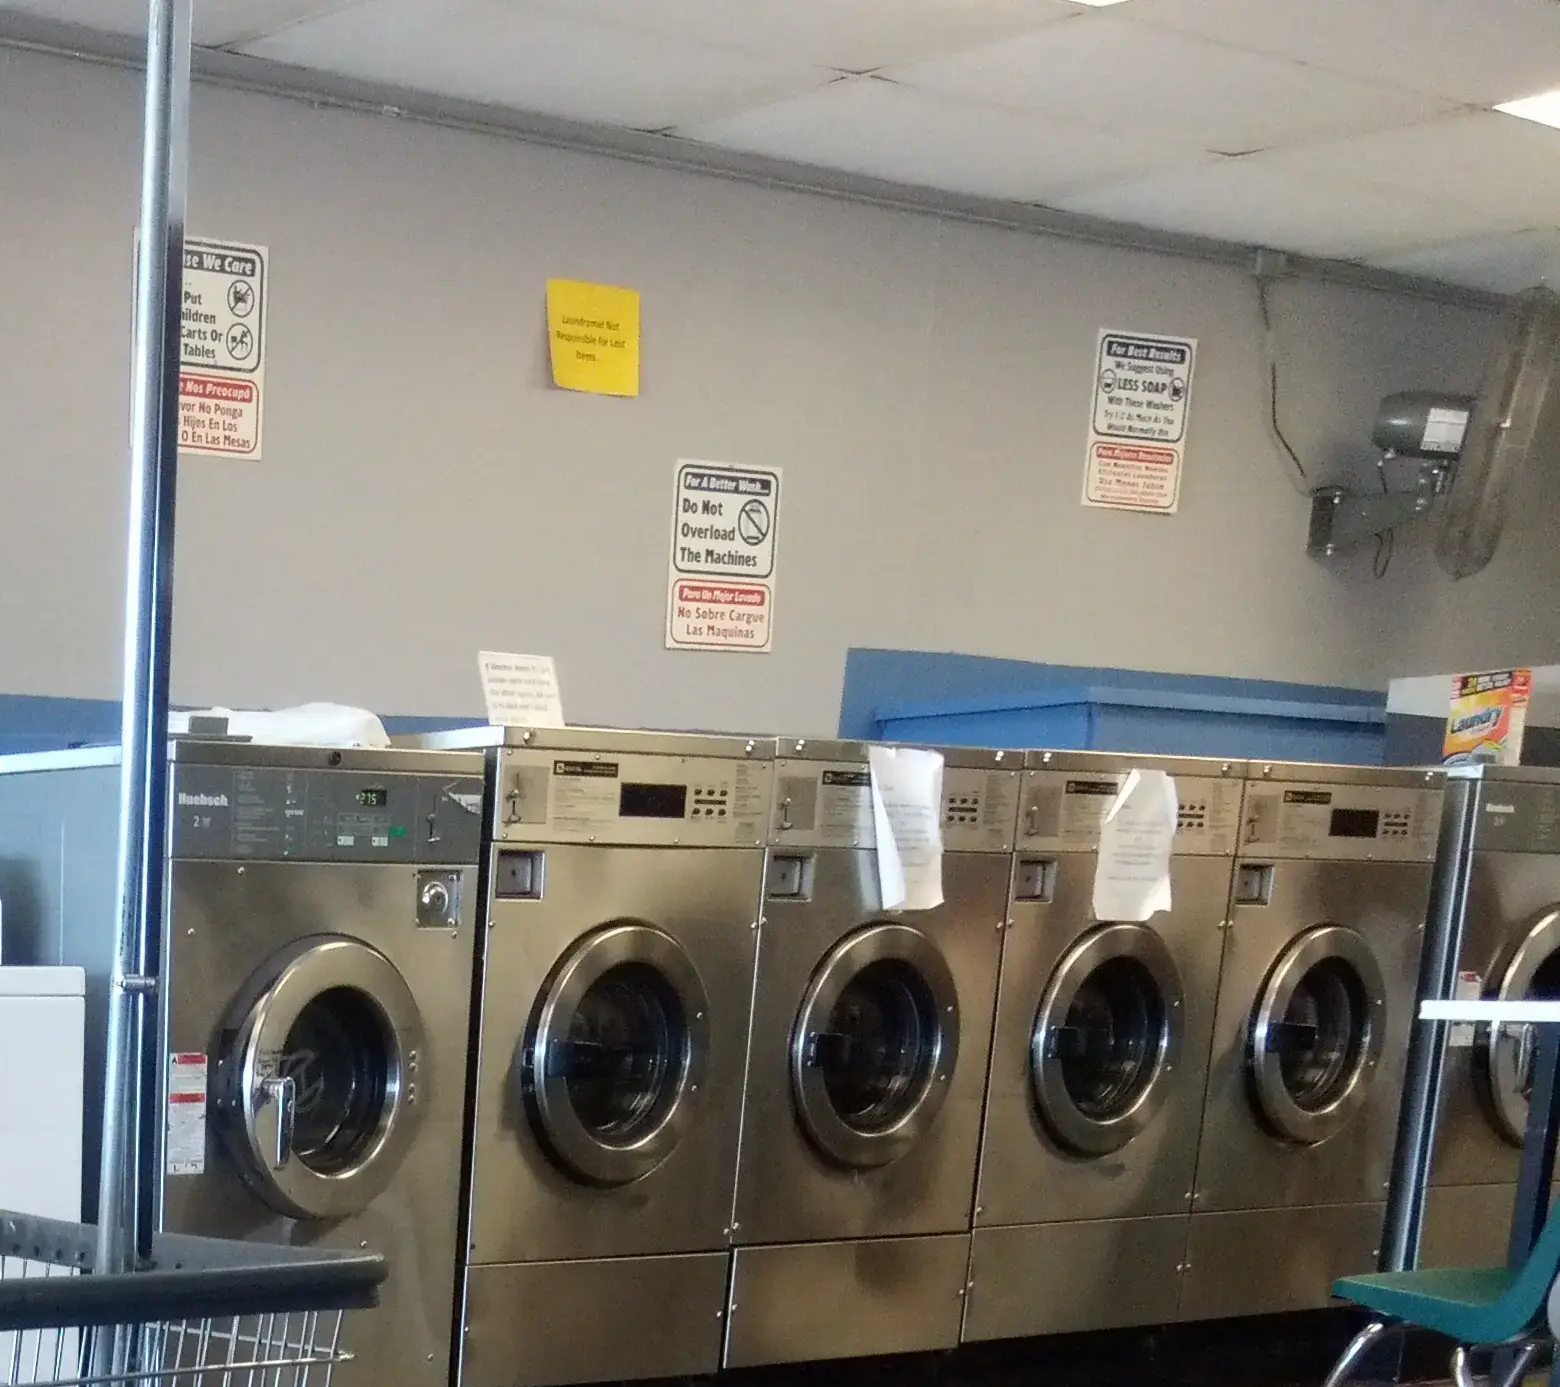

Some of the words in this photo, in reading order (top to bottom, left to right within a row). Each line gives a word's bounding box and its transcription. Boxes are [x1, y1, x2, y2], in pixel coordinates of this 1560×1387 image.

[202, 253, 221, 270] We
[224, 256, 253, 275] Care
[183, 291, 202, 305] Put
[211, 329, 224, 343] Or
[183, 343, 216, 360] Tables
[186, 380, 203, 394] Nos
[1118, 378, 1139, 391] LESS
[1142, 380, 1167, 393] SOAP
[198, 401, 211, 414] No
[214, 404, 243, 419] Ponga
[183, 415, 206, 431] Hijos
[208, 417, 220, 431] En
[222, 420, 238, 433] Los
[192, 431, 203, 444] En
[205, 433, 221, 446] Las
[223, 434, 251, 450] Mesas
[686, 474, 700, 488] For
[711, 477, 736, 492] Better
[683, 499, 697, 514] Do
[702, 500, 723, 516] Not
[681, 523, 735, 541] Overload
[680, 547, 701, 563] The
[705, 549, 757, 567] Machines
[678, 606, 691, 619] No
[696, 607, 725, 621] Sobre
[729, 609, 764, 625] Cargue
[687, 624, 702, 636] Las
[707, 625, 754, 640] Maquinas
